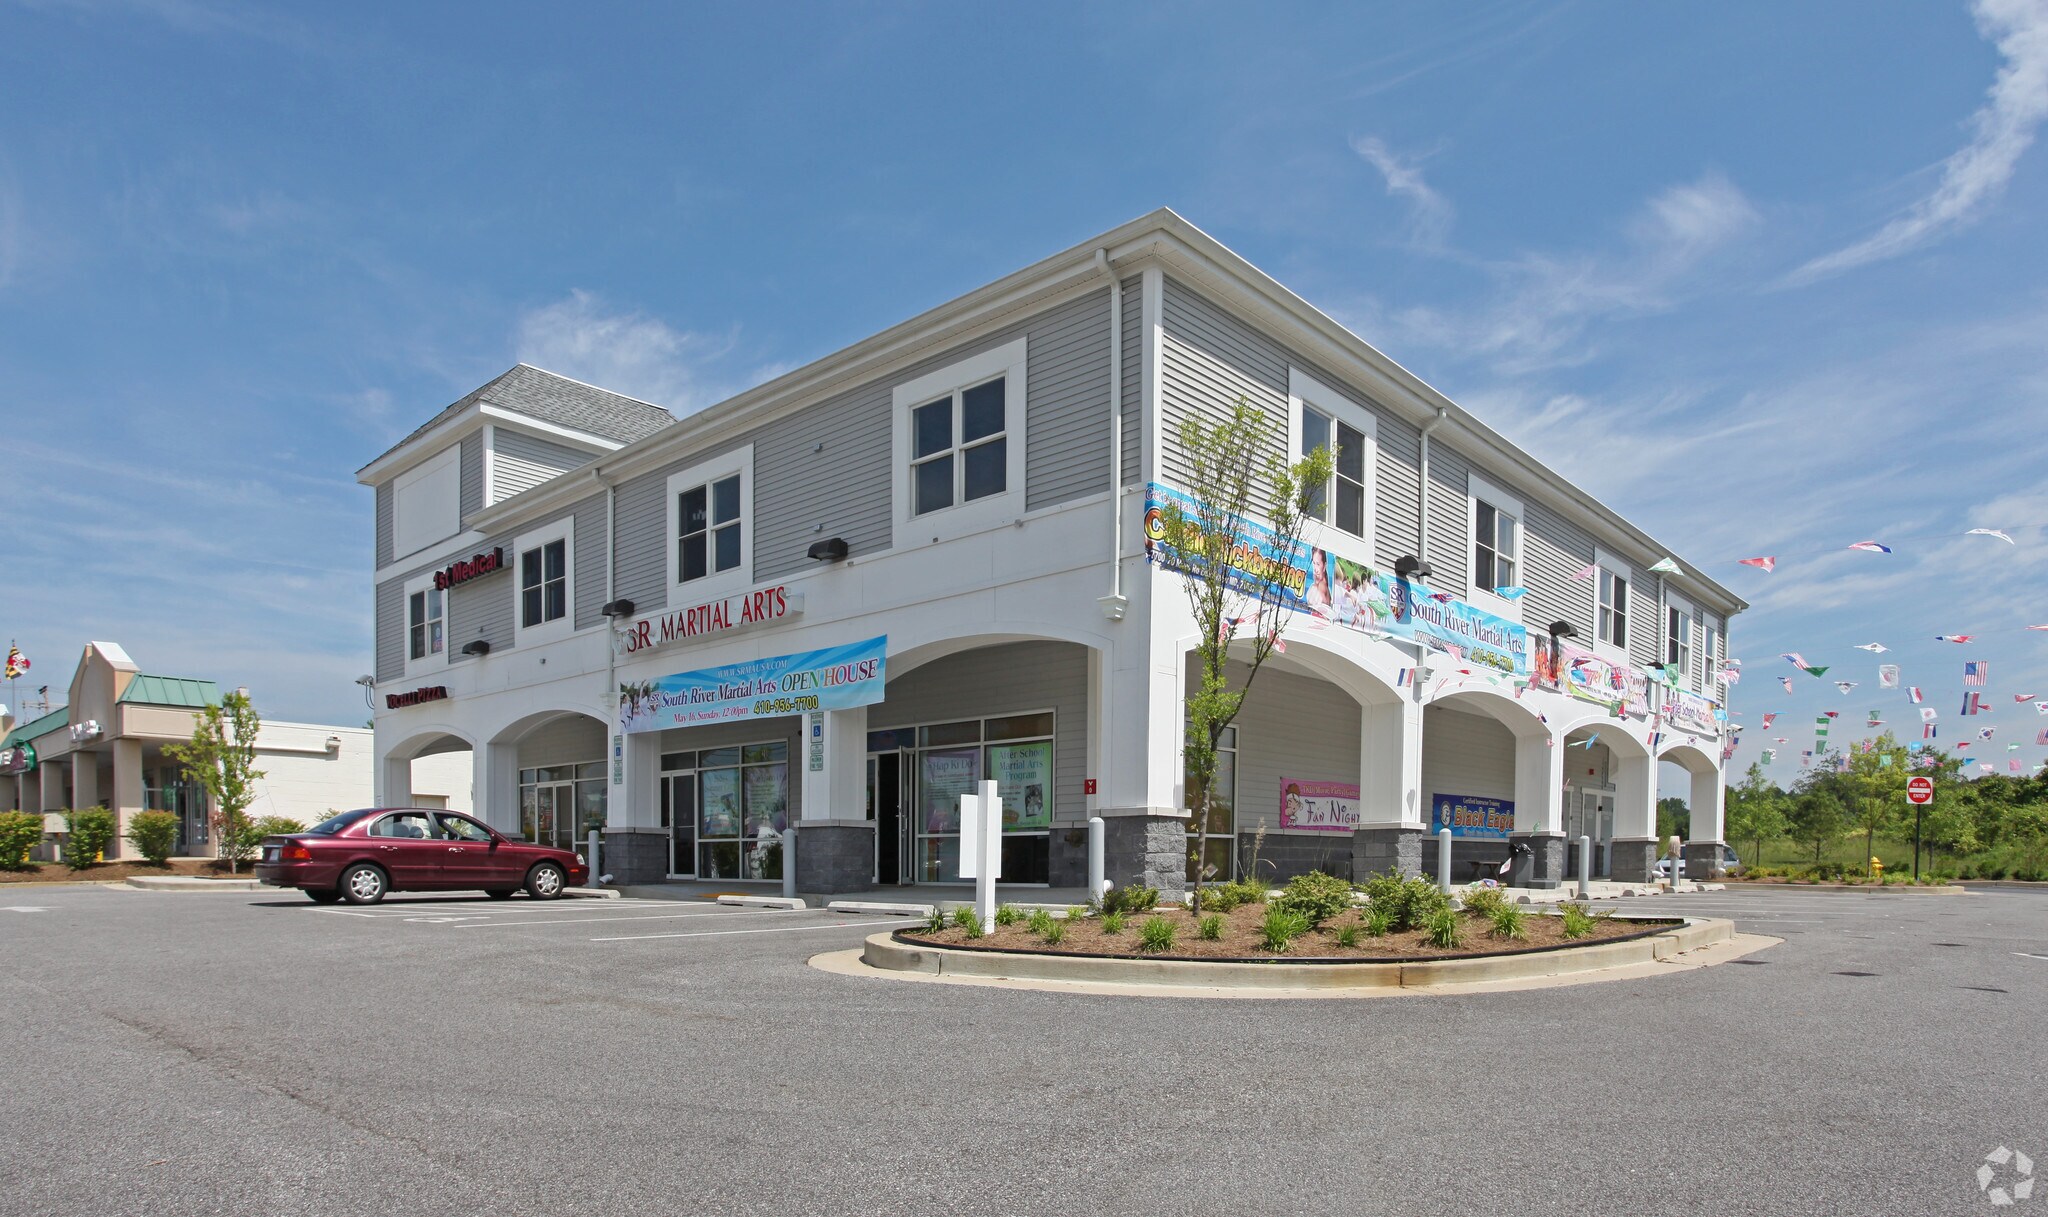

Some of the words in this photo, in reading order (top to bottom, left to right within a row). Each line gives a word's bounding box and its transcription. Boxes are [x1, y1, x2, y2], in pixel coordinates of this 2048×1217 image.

[433, 571, 450, 590] 1st
[451, 549, 498, 584] Medical
[1390, 586, 1404, 603] SR
[626, 620, 652, 653] SR
[660, 600, 732, 642] MARTIAL
[740, 586, 786, 624] ARTS
[1409, 592, 1441, 626] South
[1444, 605, 1469, 636] River
[1472, 616, 1503, 649] Martial
[1505, 628, 1523, 654] Arts
[662, 690, 688, 708] South
[690, 686, 716, 704] River
[718, 680, 753, 701] Martial
[755, 677, 777, 695] Arts
[781, 670, 820, 692] OPEN
[823, 658, 878, 687] HOUSE
[417, 686, 443, 703] PIZZA
[753, 695, 819, 715] 410-956-7700
[674, 712, 686, 723] May
[1019, 747, 1045, 758] School
[1000, 759, 1025, 771] Martial
[1027, 759, 1043, 769] Arts
[1005, 770, 1037, 781] Program
[1453, 804, 1486, 828] Black
[1486, 807, 1515, 833] Eagle
